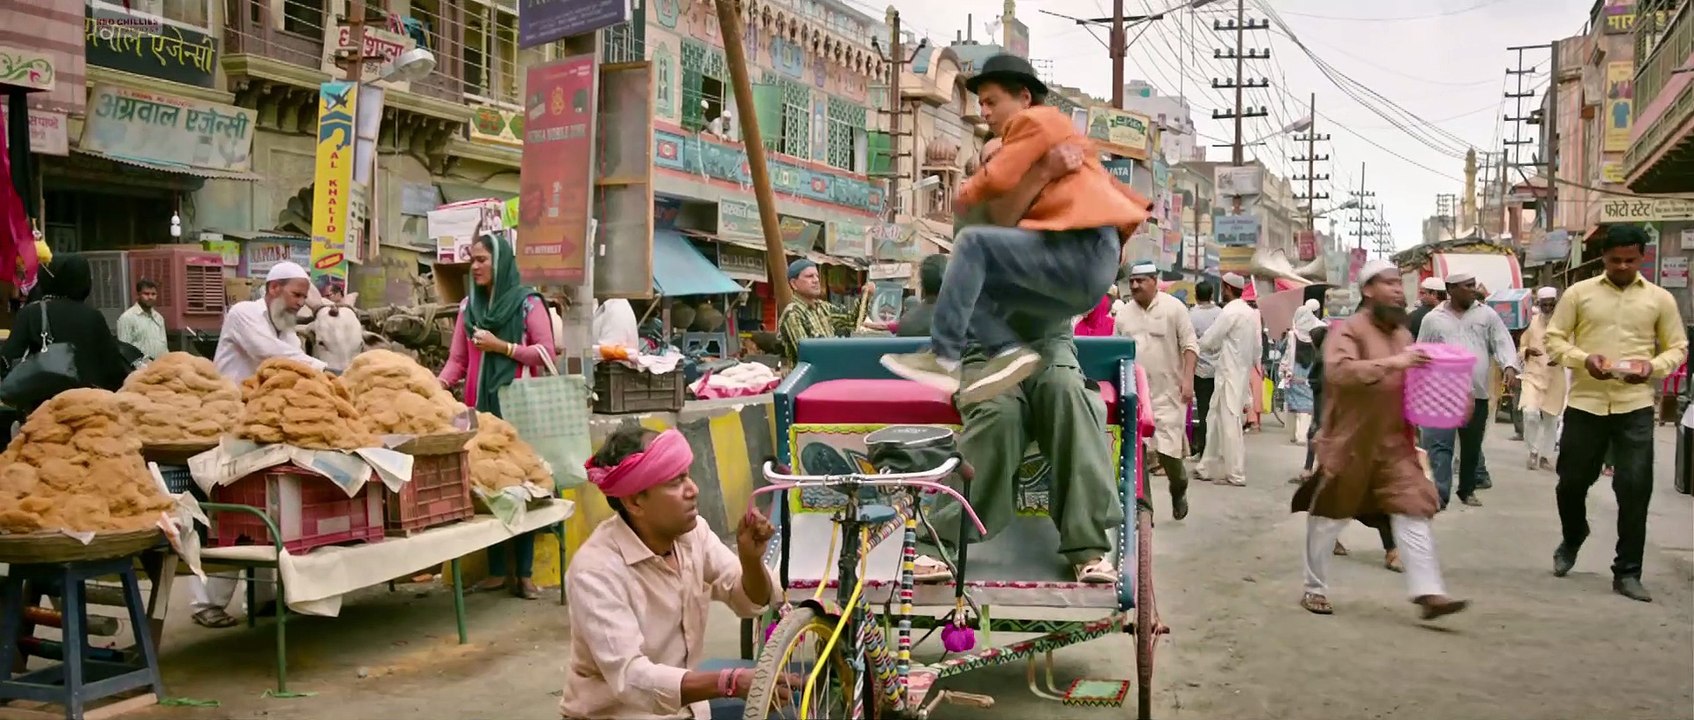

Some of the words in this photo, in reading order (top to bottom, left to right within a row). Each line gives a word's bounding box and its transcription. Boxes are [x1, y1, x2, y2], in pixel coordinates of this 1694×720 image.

[95, 93, 181, 128] अग्रवाल
[330, 151, 339, 168] AL
[326, 180, 338, 233] KHALID
[1605, 200, 1629, 218] फोटो
[1631, 200, 1652, 218] स्टेट
